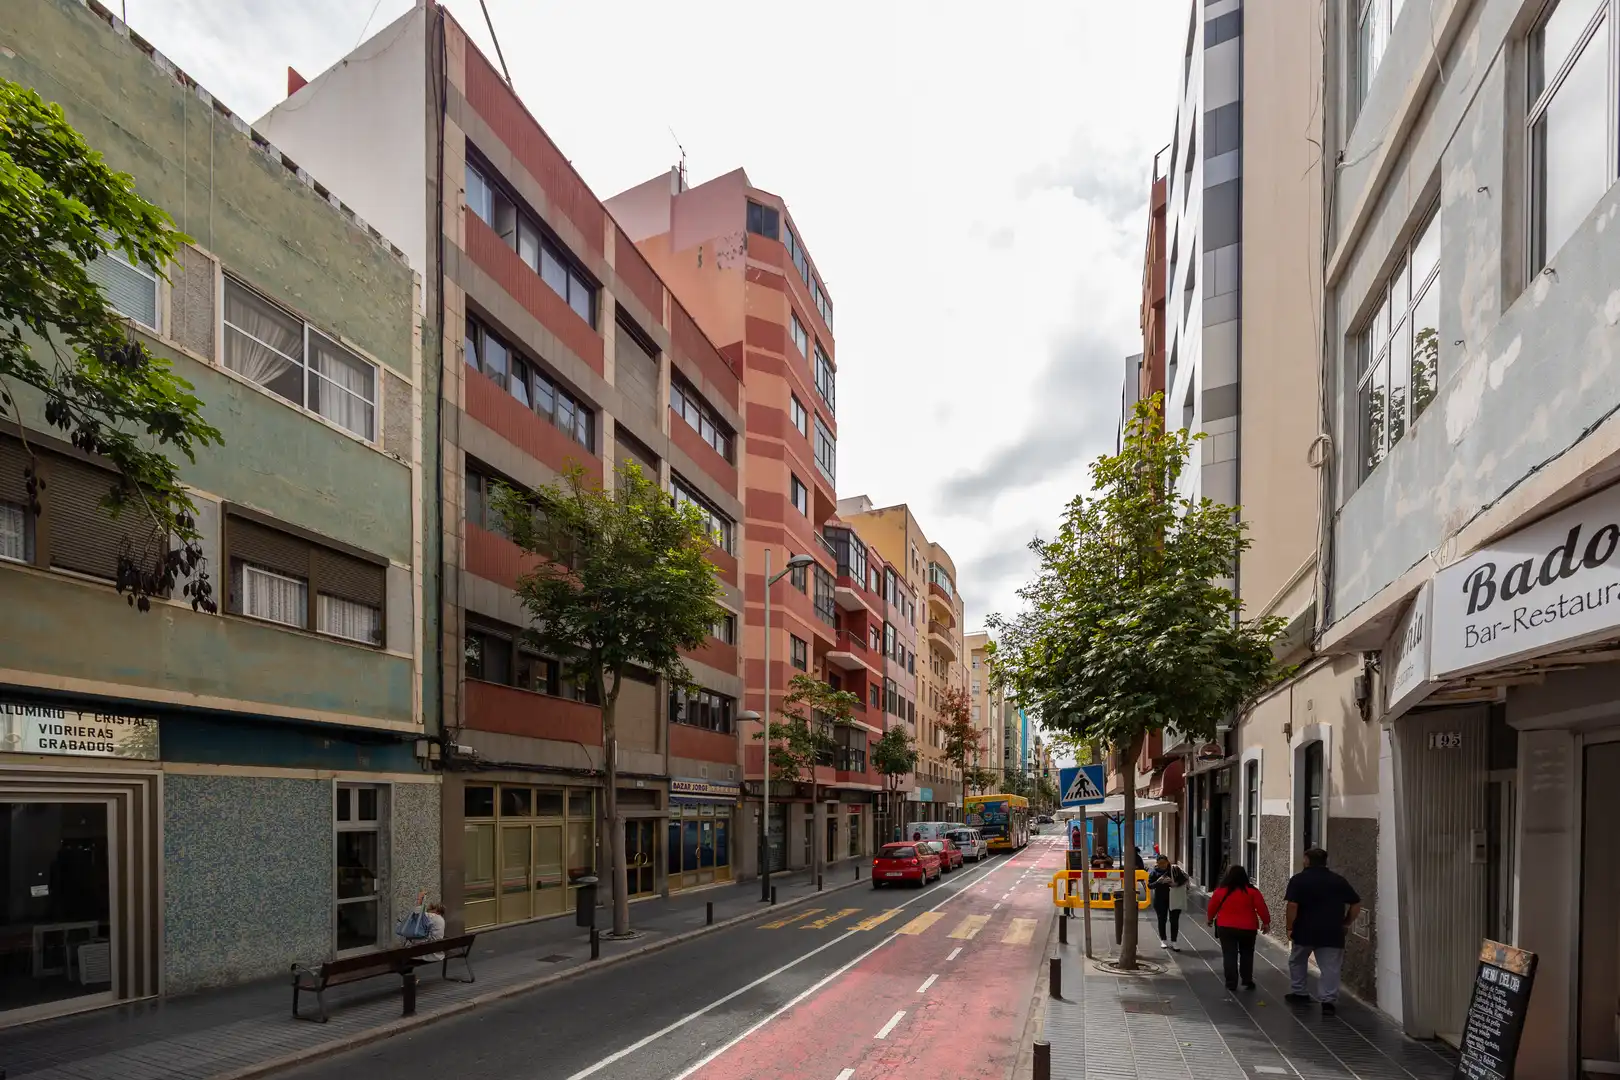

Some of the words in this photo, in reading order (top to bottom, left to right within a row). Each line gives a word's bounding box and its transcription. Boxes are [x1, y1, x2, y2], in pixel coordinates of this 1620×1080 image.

[1465, 583, 1620, 649] Bar-Restaur
[76, 711, 84, 721] Y
[94, 711, 148, 727] CRISTAL
[38, 723, 114, 739] VIDRIERAS
[39, 738, 114, 753] GRABADOS
[1432, 732, 1461, 748] 195
[672, 782, 691, 791] BAZAR
[692, 784, 709, 793] JORGE
